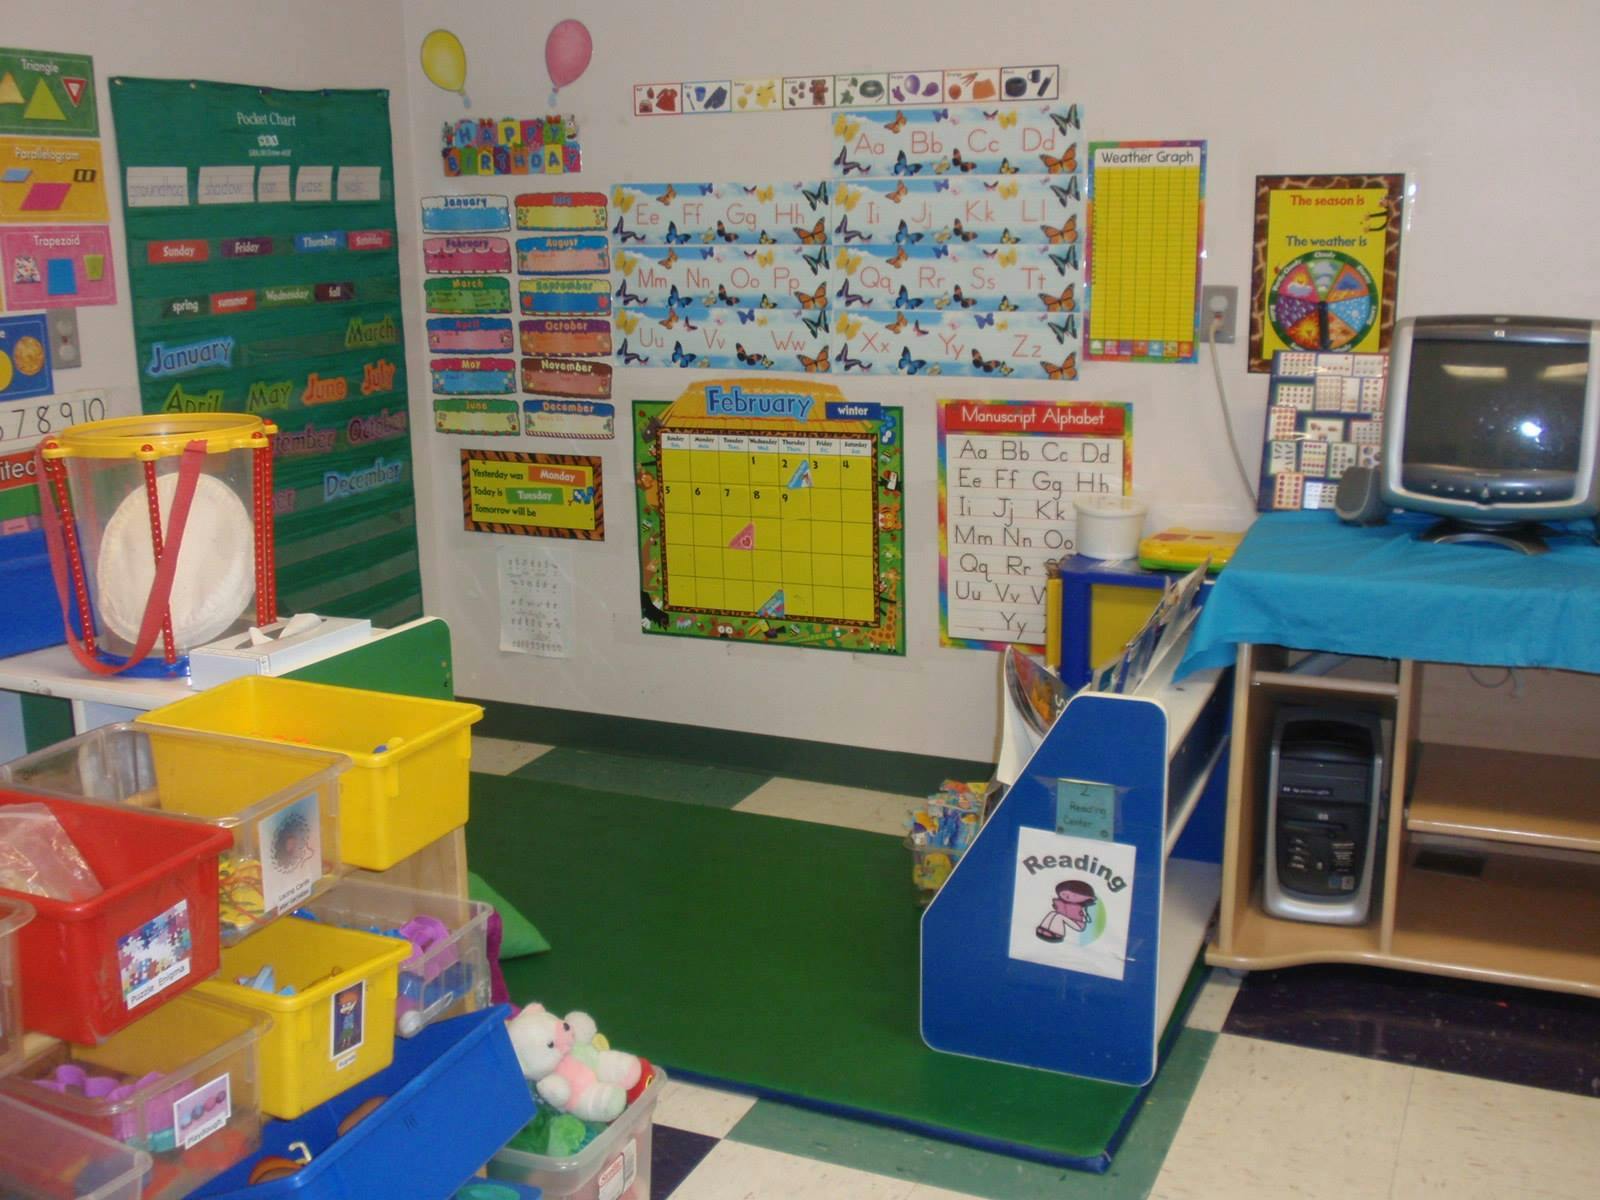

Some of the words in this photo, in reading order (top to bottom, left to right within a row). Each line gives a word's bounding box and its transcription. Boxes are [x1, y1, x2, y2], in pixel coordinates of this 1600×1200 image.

[20, 58, 60, 74] Triangle
[236, 111, 268, 126] Pocket
[270, 112, 297, 127] Chart
[457, 125, 560, 144] HAPPY
[854, 133, 885, 155] Aa
[911, 130, 943, 154] Bb
[967, 128, 1000, 152] Cc
[1022, 127, 1056, 152] Dd
[447, 152, 577, 172] BIRTHDAY
[1101, 151, 1153, 164] Weather
[1156, 151, 1194, 166] Graph
[443, 196, 488, 208] January
[1290, 194, 1312, 206] The
[1315, 196, 1354, 206] season
[1355, 194, 1365, 206] is
[636, 203, 660, 225] Ee
[683, 203, 704, 225] Ff
[726, 203, 757, 231] Gg
[775, 203, 805, 225] Hh
[866, 201, 880, 225] Ii
[911, 200, 933, 229] Jj
[965, 200, 995, 223] Kk
[1021, 199, 1046, 222] Ll
[33, 233, 81, 248] Trapezoid
[162, 245, 195, 257] Sunday
[234, 241, 260, 255] Friday
[303, 234, 337, 249] Thursday
[1286, 235, 1308, 247] The
[1310, 236, 1356, 247] weather
[1359, 235, 1367, 247] is
[638, 268, 667, 289] Mm
[686, 267, 710, 288] Nn
[730, 266, 760, 289] Oo
[773, 266, 800, 296] Pp
[859, 266, 896, 295] Qq
[918, 266, 945, 289] Rr
[971, 266, 996, 290] Ss
[1020, 266, 1047, 290] Tt
[172, 300, 199, 313] spring
[328, 286, 341, 298] fall
[347, 318, 395, 343] March
[544, 320, 589, 332] October
[639, 328, 664, 348] Uu
[703, 328, 726, 350] Vv
[770, 329, 806, 351] Ww
[860, 331, 891, 353] Xx
[938, 333, 965, 360] Yy
[1011, 333, 1043, 358] Zz
[151, 340, 231, 374] January
[461, 359, 481, 370] May
[541, 358, 593, 373] November
[363, 362, 396, 392] July
[166, 389, 220, 413] April
[250, 382, 292, 412] May
[304, 374, 347, 402] June
[707, 388, 811, 418] February
[837, 404, 869, 416] winter
[542, 400, 594, 413] December
[11, 408, 25, 439] 7
[37, 404, 51, 434] 8
[60, 402, 75, 426] 9
[83, 398, 105, 423] 10
[961, 406, 1036, 430] Manuscript
[1042, 407, 1106, 431] Alphabet
[275, 428, 334, 453] tember
[959, 439, 988, 460] Aa
[1001, 439, 1030, 461] Bb
[1041, 441, 1069, 463] Cc
[1081, 441, 1110, 464] Dd
[750, 455, 756, 465] 1
[781, 458, 788, 468] 2
[812, 460, 819, 470] 3
[842, 460, 849, 469] 4
[326, 462, 401, 497] December
[471, 467, 509, 481] Yesterday
[510, 472, 524, 481] was
[539, 470, 576, 483] Monday
[958, 467, 982, 489] Ee
[995, 468, 1019, 489] Ff
[1032, 470, 1063, 500] Gg
[1076, 471, 1110, 493] Hh
[473, 486, 496, 498] Today
[496, 488, 503, 497] is
[517, 489, 553, 502] Tuesday
[664, 484, 671, 495] 5
[694, 486, 701, 497] 6
[724, 488, 730, 497] 7
[753, 489, 761, 500] 8
[781, 493, 788, 503] 9
[474, 503, 511, 515] Tomorrow
[511, 506, 526, 516] will
[527, 508, 537, 517] be
[959, 495, 972, 517] Ii
[992, 497, 1014, 527] Jj
[1036, 499, 1065, 520] Kk
[954, 524, 993, 545] Mm
[1003, 527, 1032, 548] Nn
[1043, 528, 1074, 550] Oo
[959, 552, 992, 583] Qq
[1006, 555, 1032, 576] Rr
[955, 580, 981, 601] Uu
[994, 583, 1020, 603] Vv
[1000, 611, 1028, 641] Yy
[1079, 784, 1091, 797] 2
[1069, 801, 1108, 819] Reading
[1063, 816, 1093, 829] Center
[1022, 853, 1128, 893] Reading
